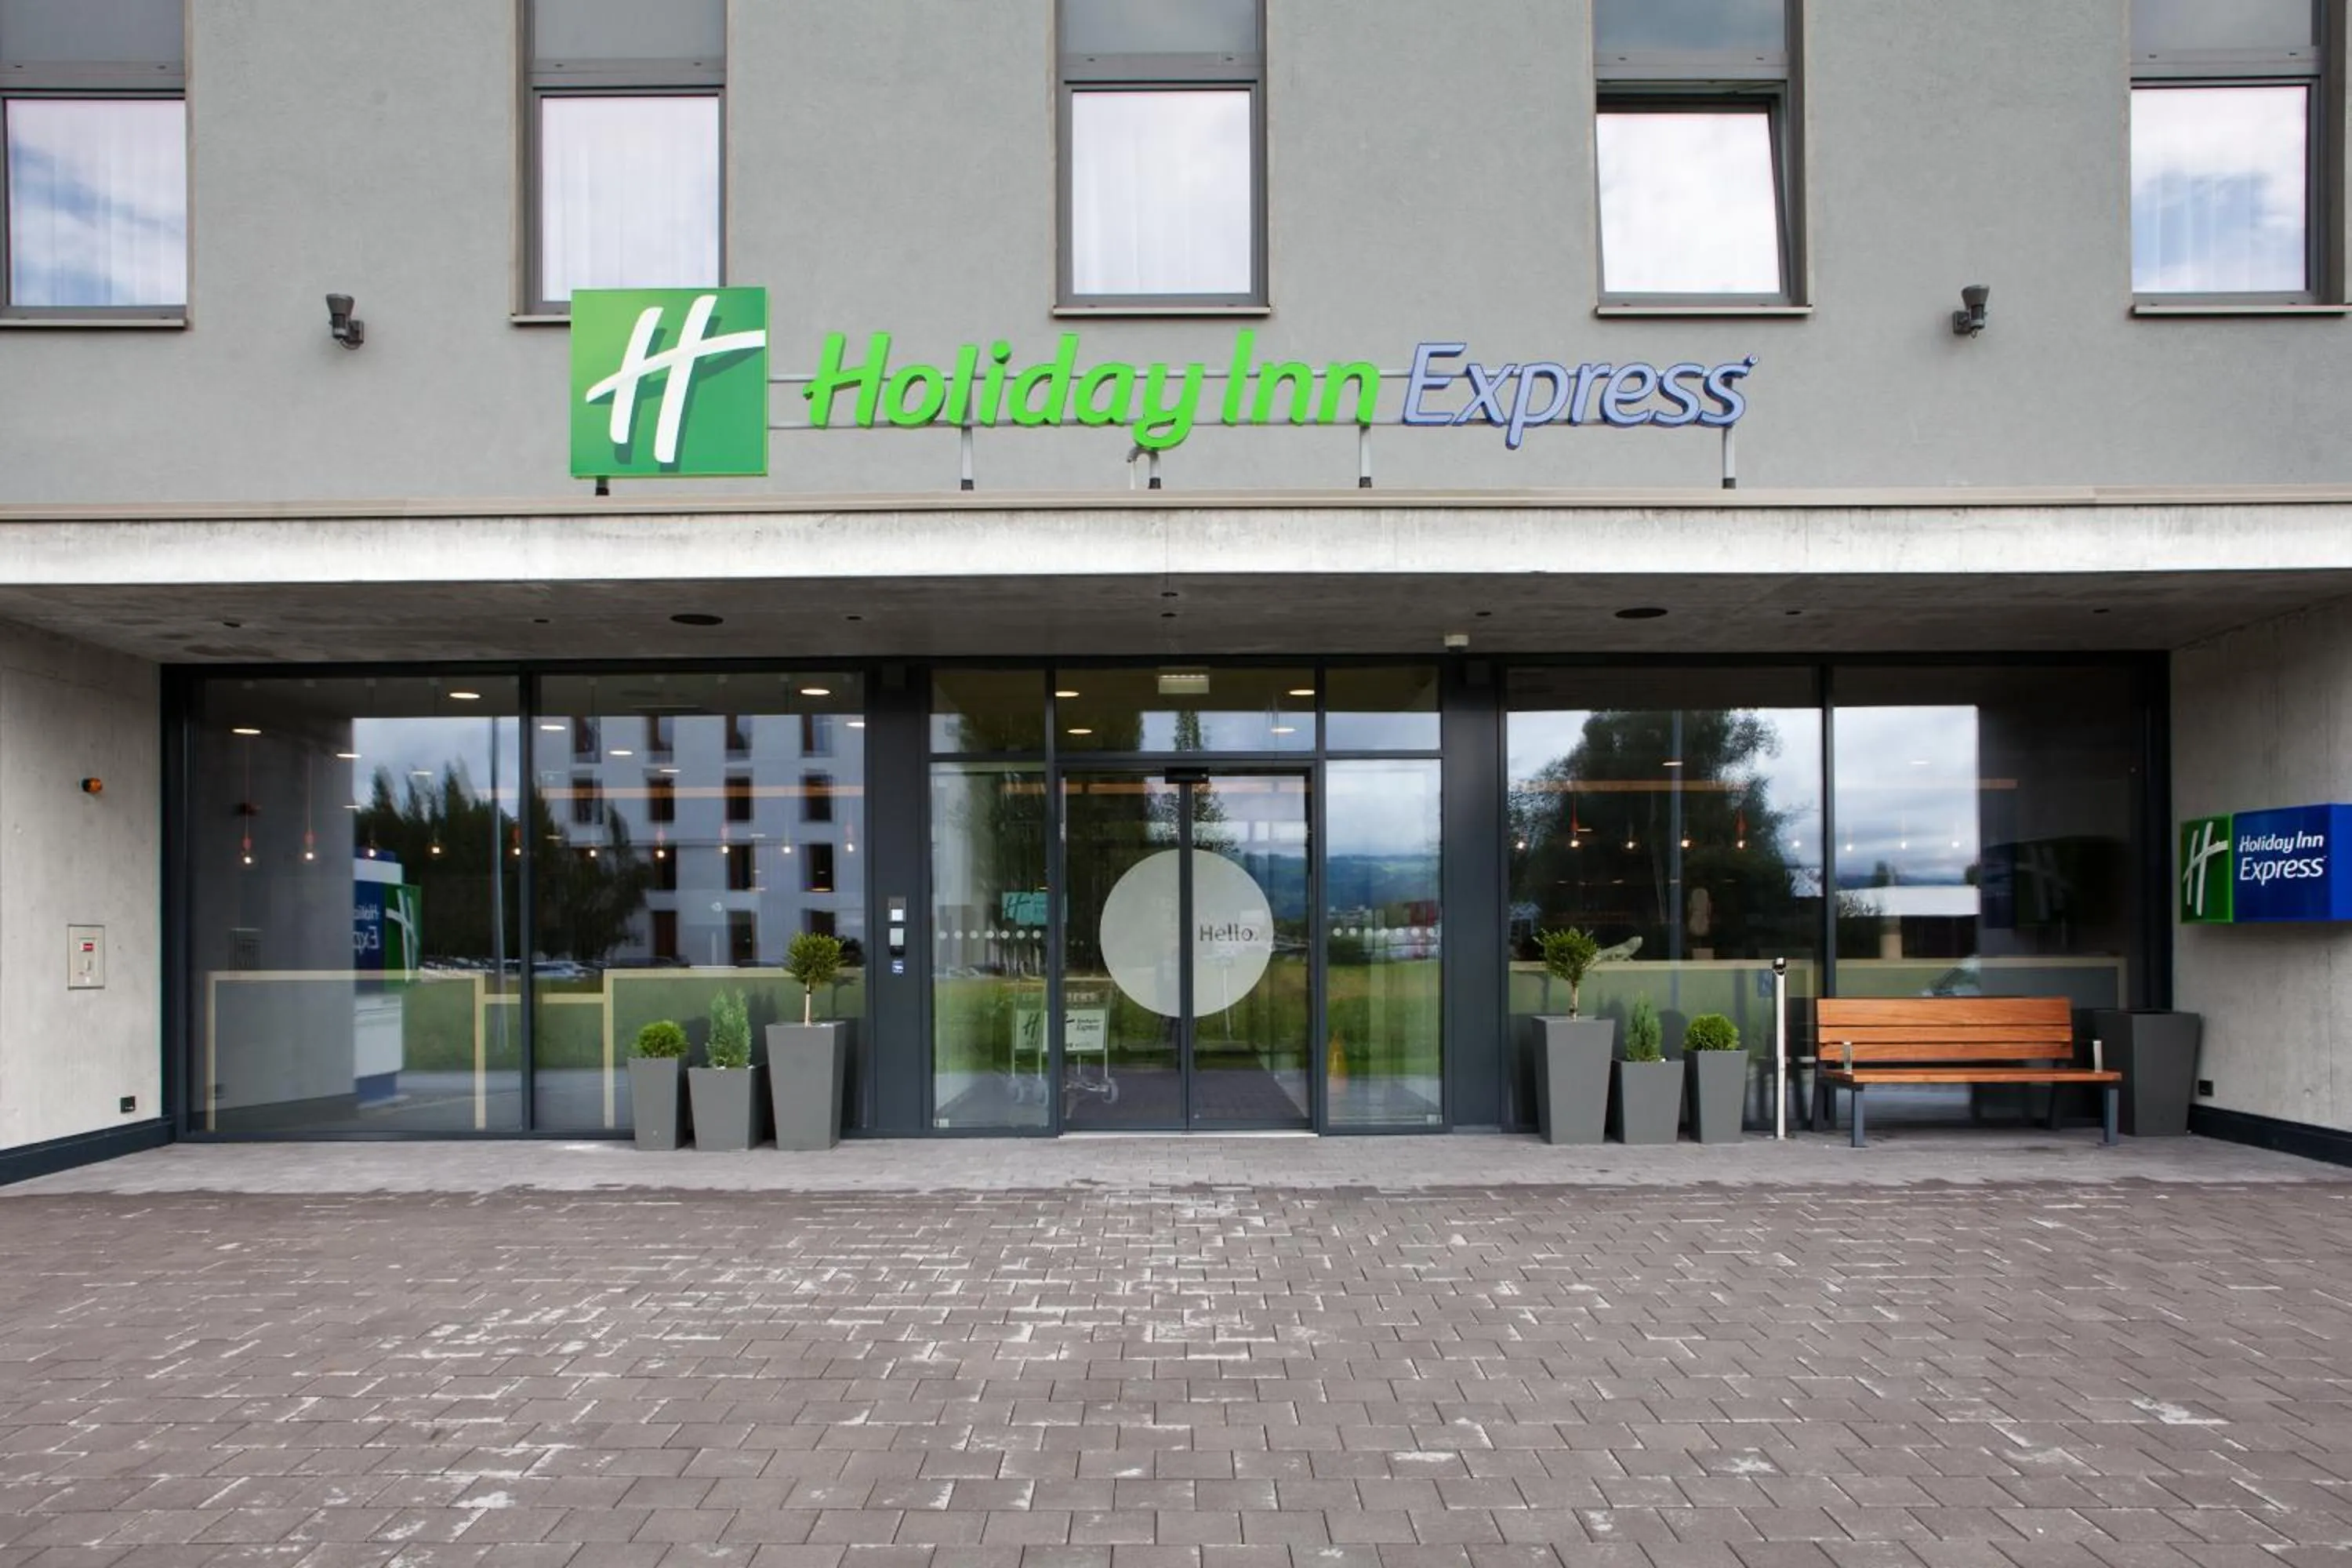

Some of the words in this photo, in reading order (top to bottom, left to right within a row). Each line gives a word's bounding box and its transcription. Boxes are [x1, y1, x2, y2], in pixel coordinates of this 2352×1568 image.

[586, 294, 766, 463] H
[803, 331, 1205, 451] Holiday
[1221, 328, 1380, 426] Inn
[1402, 342, 1747, 449] Express
[2238, 833, 2294, 853] Holiday
[2296, 830, 2325, 849] Inn
[2238, 857, 2325, 886] Express
